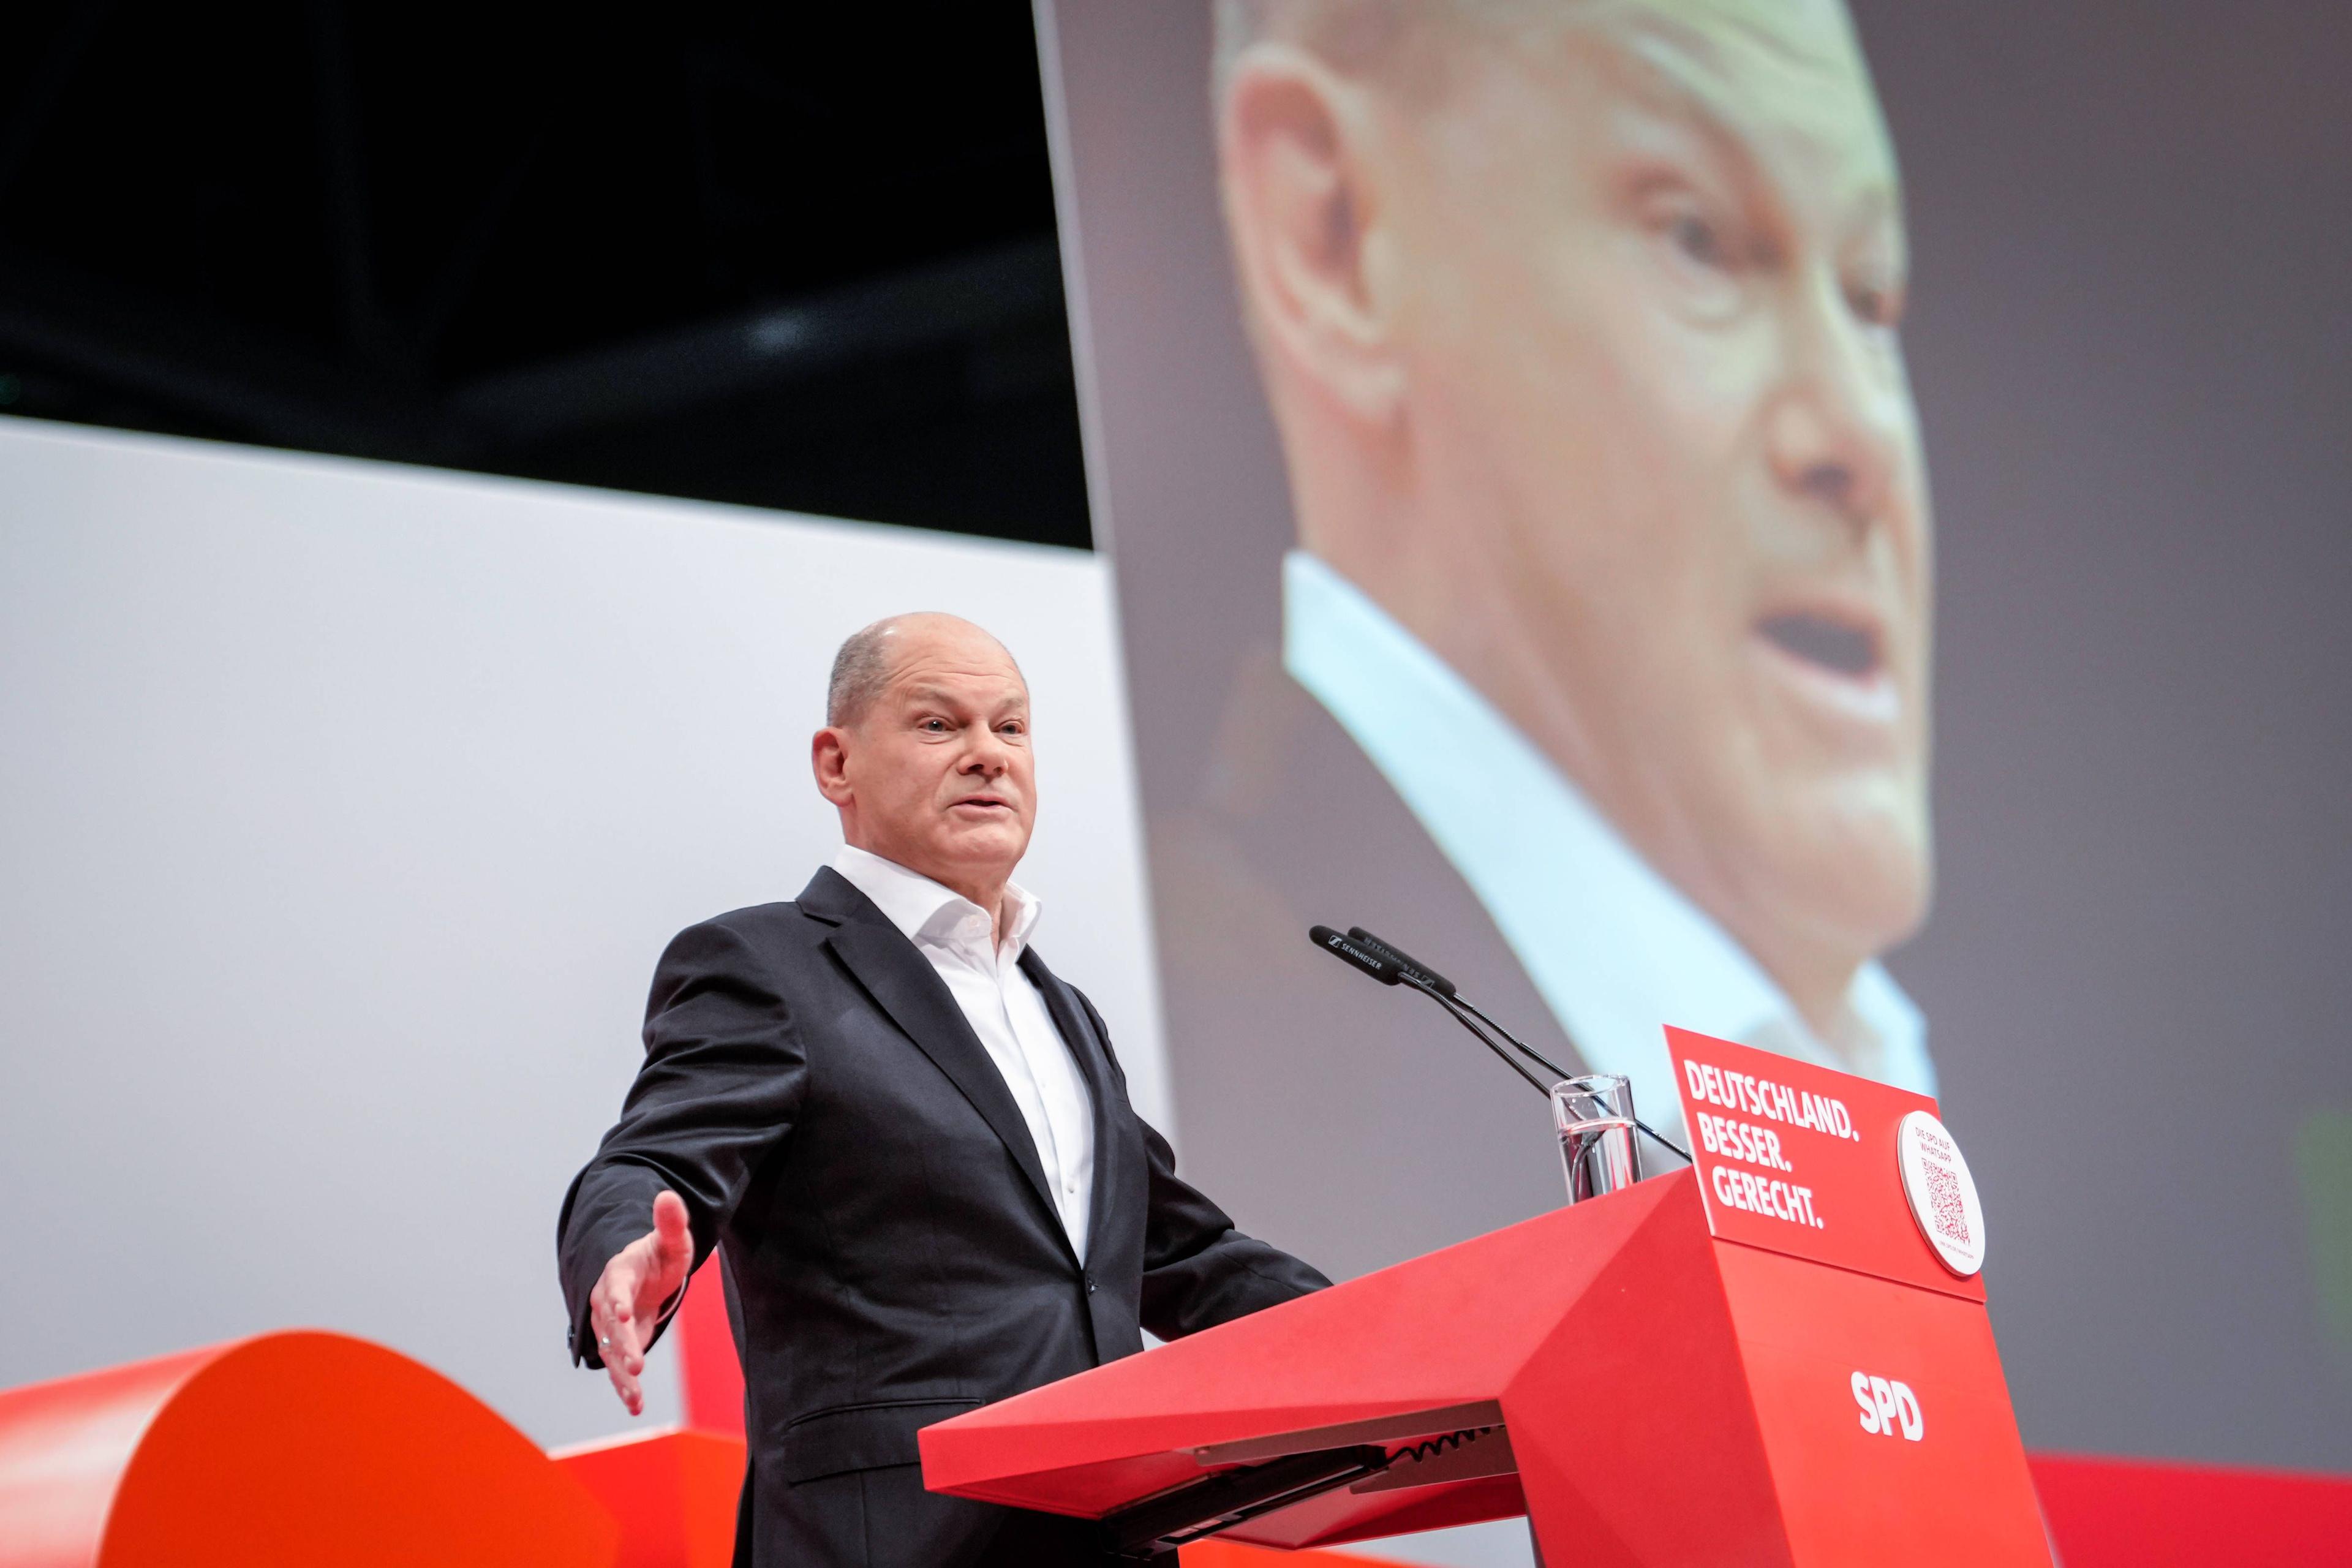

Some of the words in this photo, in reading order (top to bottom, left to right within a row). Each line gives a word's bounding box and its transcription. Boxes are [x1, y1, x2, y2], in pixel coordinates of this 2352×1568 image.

[1341, 943, 1382, 970] SENNHEISER
[1683, 1059, 1860, 1142] DEUTSCHLAND.
[1697, 1112, 1792, 1172] BESSER.
[1915, 1127, 1926, 1140] DIE
[1926, 1132, 1937, 1145] SPD
[1939, 1138, 1951, 1150] AUF
[1920, 1142, 1951, 1163] WHATSAPP
[1712, 1166, 1824, 1229] GERECHT.
[1850, 1371, 1924, 1442] SPD
